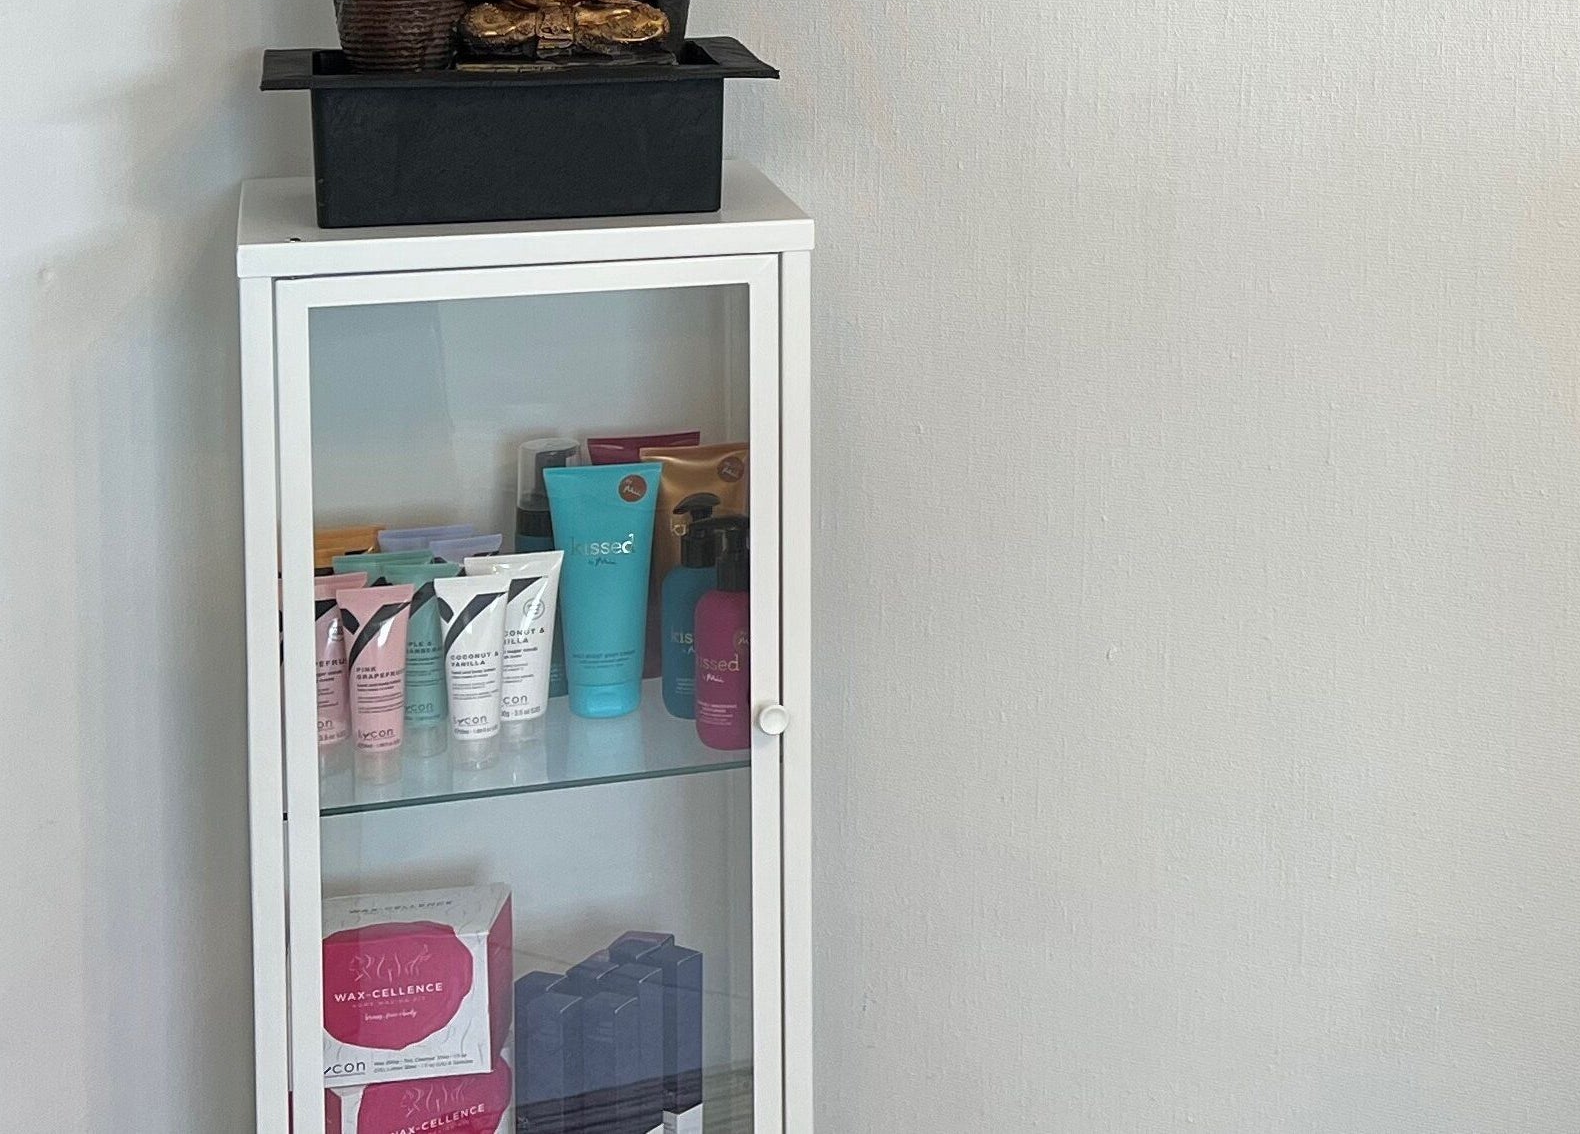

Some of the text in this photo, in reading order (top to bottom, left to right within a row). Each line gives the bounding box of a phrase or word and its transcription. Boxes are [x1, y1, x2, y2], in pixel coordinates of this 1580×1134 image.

[570, 534, 636, 555] kissed
[450, 652, 491, 660] COCONUT
[335, 982, 443, 1002] WAX-CELLENCE
